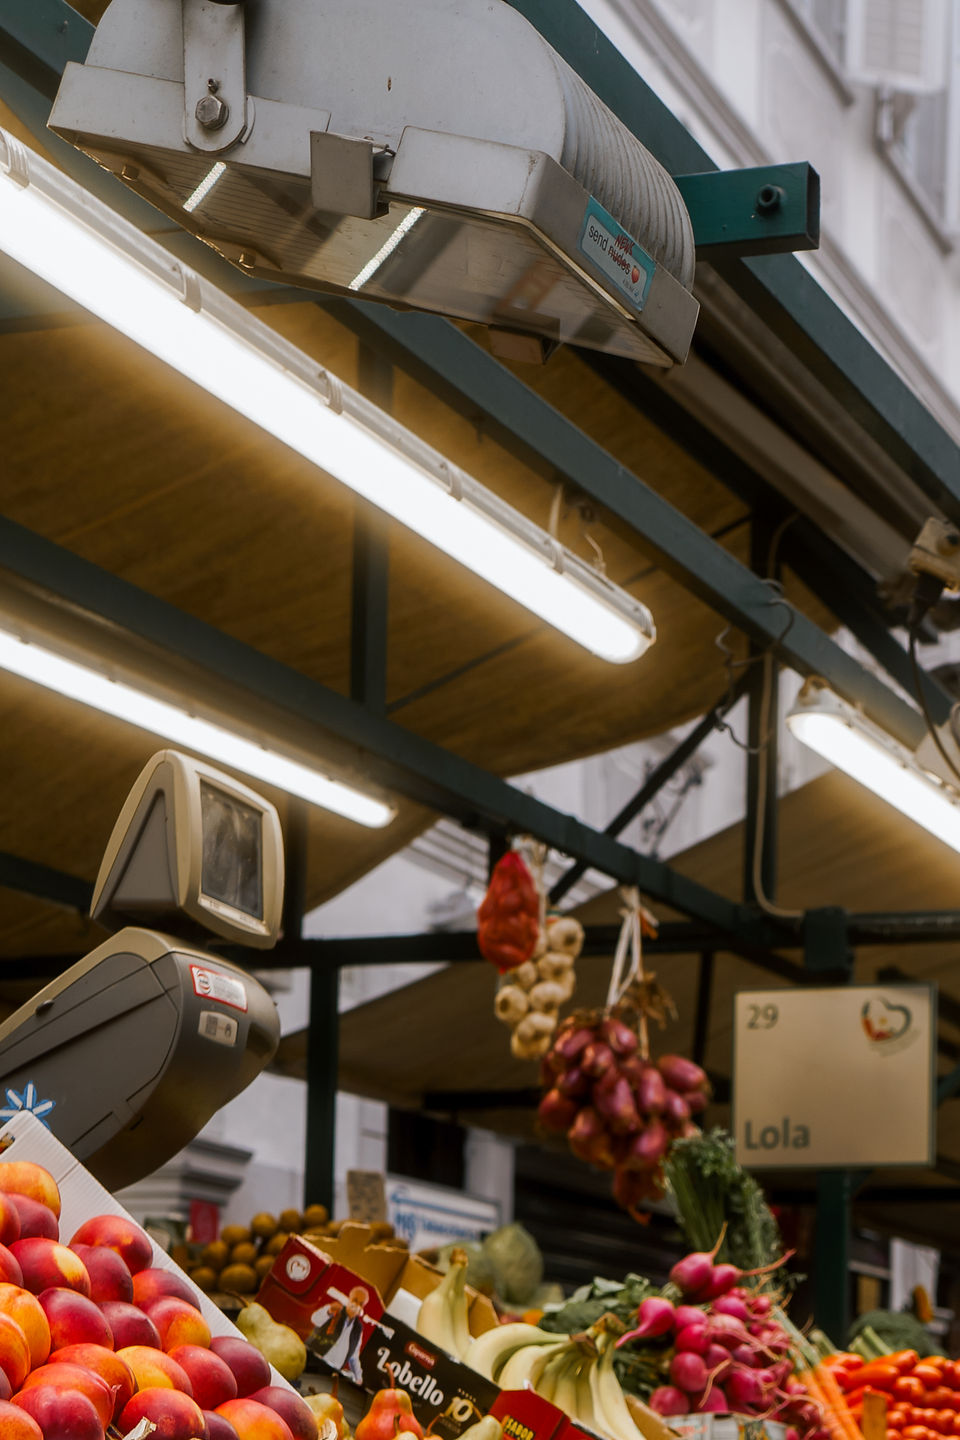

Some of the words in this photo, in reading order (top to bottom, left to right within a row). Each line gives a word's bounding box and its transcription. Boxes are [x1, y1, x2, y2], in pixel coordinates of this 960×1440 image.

[588, 225, 609, 252] send
[747, 1002, 779, 1030] 29
[744, 1116, 810, 1150] Lola
